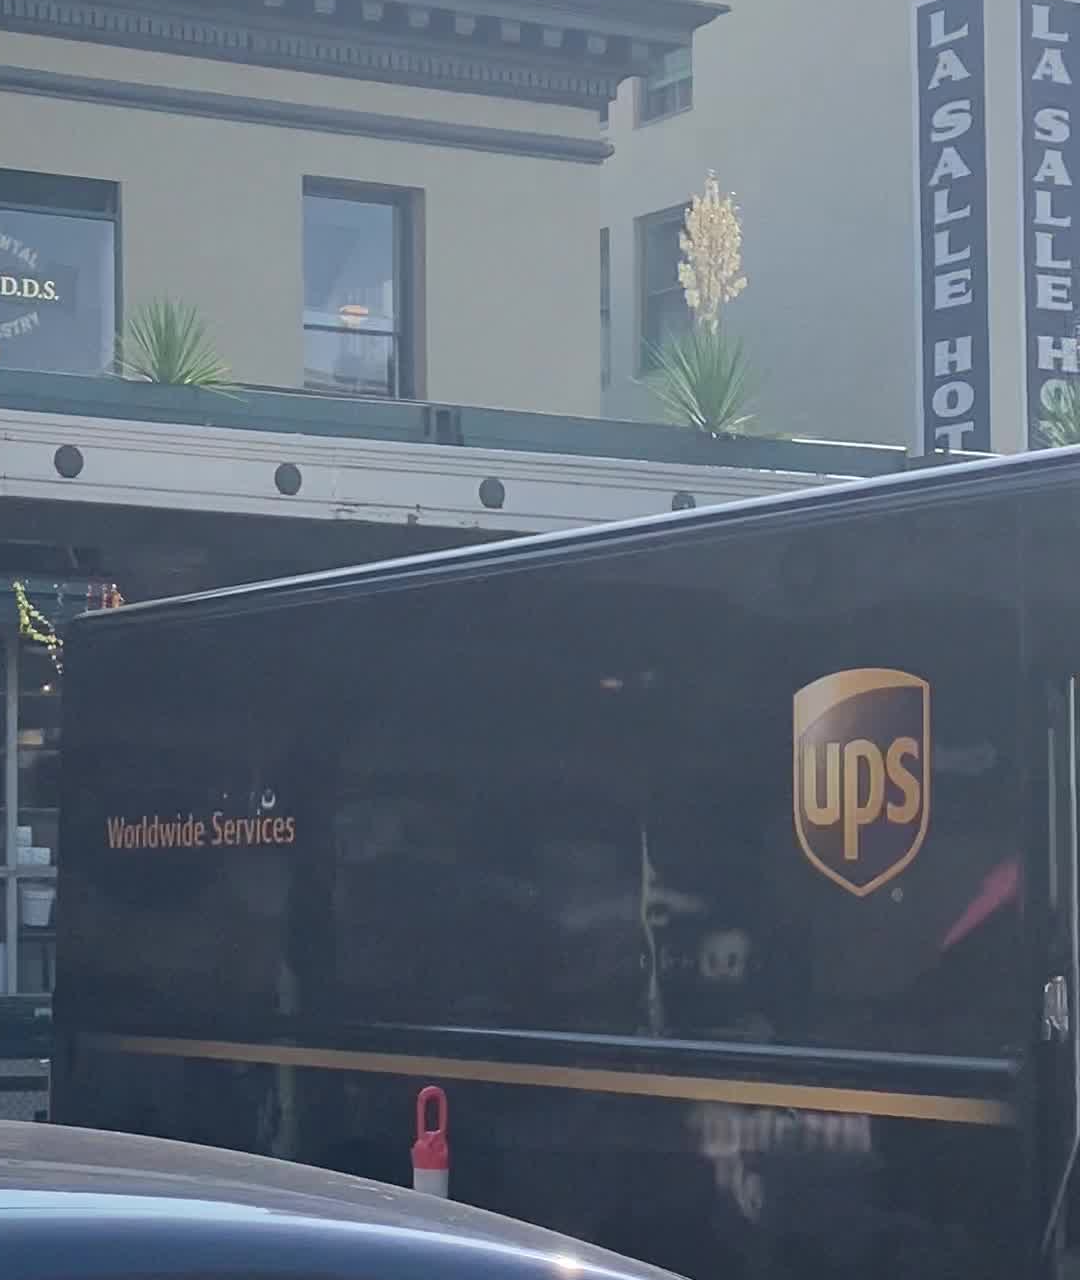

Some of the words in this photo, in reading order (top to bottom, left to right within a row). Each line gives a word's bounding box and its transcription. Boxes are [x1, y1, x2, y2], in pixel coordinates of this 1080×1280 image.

[927, 9, 971, 90] LA
[1031, 3, 1073, 85] LA
[928, 98, 973, 311] SALLE
[1032, 107, 1074, 311] SALLE
[0, 275, 60, 302] D.D.S.
[107, 813, 206, 848] Worldwide
[211, 810, 296, 845] Services
[803, 736, 921, 860] ups
